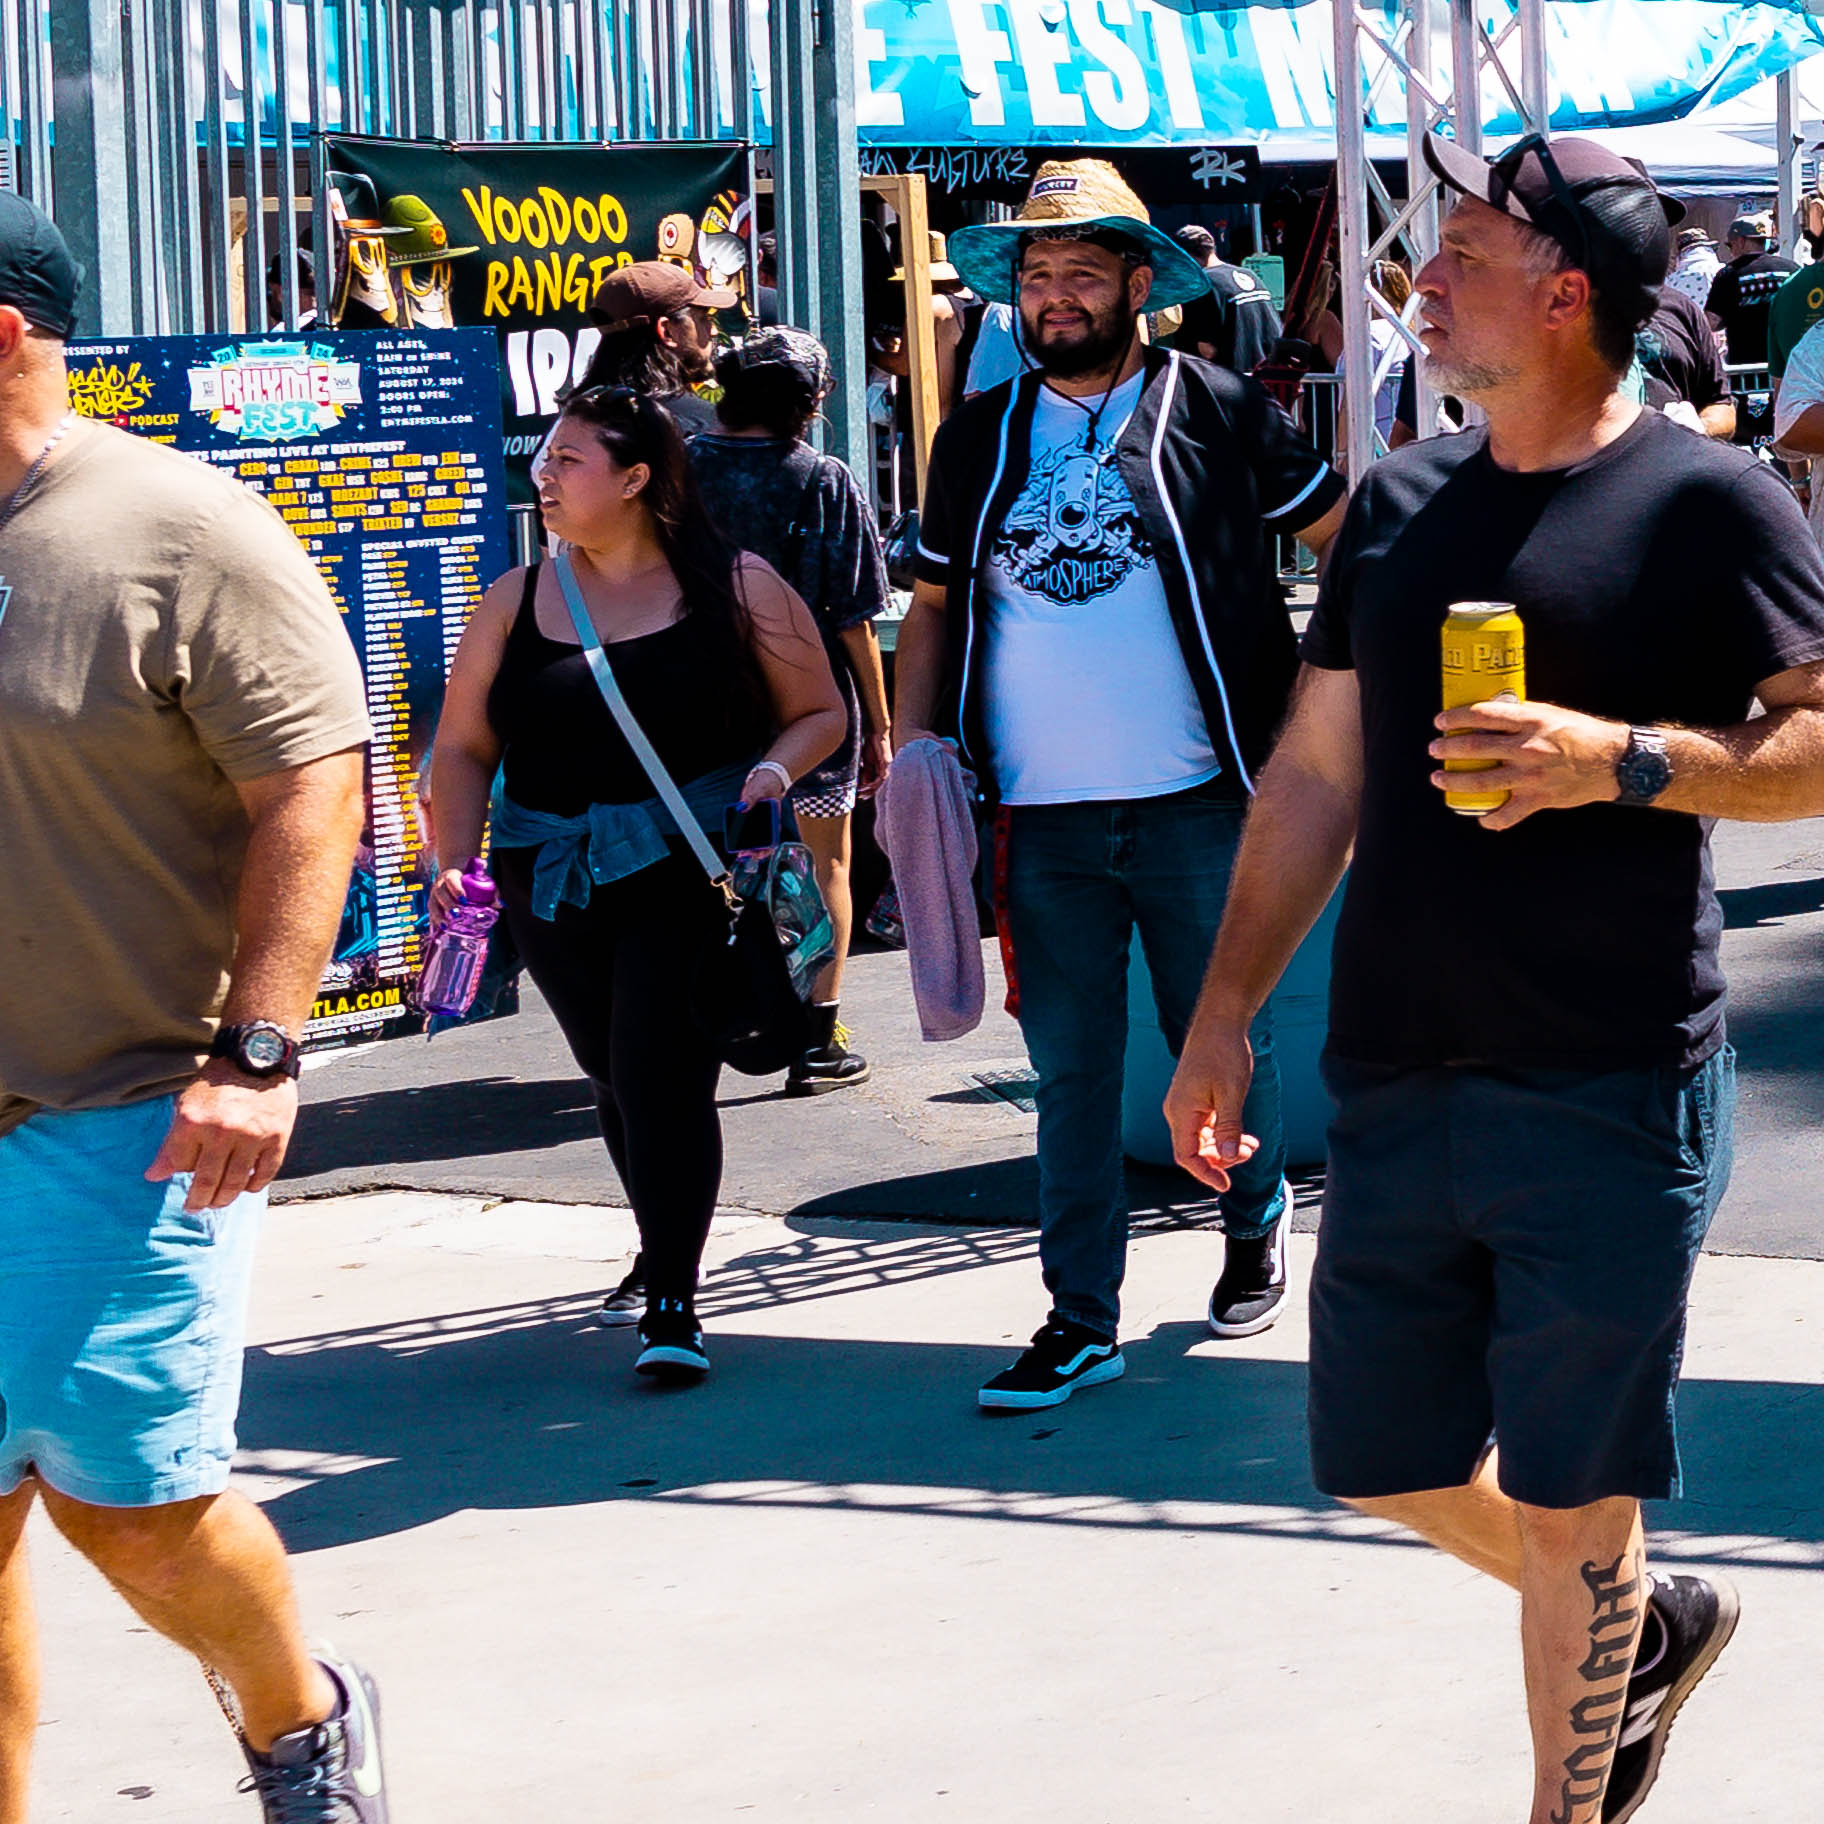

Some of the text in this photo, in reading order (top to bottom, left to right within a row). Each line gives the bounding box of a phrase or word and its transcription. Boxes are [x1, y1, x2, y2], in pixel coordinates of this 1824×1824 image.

[461, 185, 628, 249] VOODOO
[483, 252, 634, 317] RANGE
[62, 345, 130, 357] RESENTED BY
[222, 366, 330, 414] RHYME
[379, 379, 418, 388] AUGUST
[130, 414, 179, 426] PODCAST
[242, 401, 319, 434] FEST
[280, 446, 309, 457] LIVE
[312, 445, 329, 455] AT
[1022, 558, 1125, 598] ATMOSPHERE
[312, 988, 400, 1018] TLA.COM
